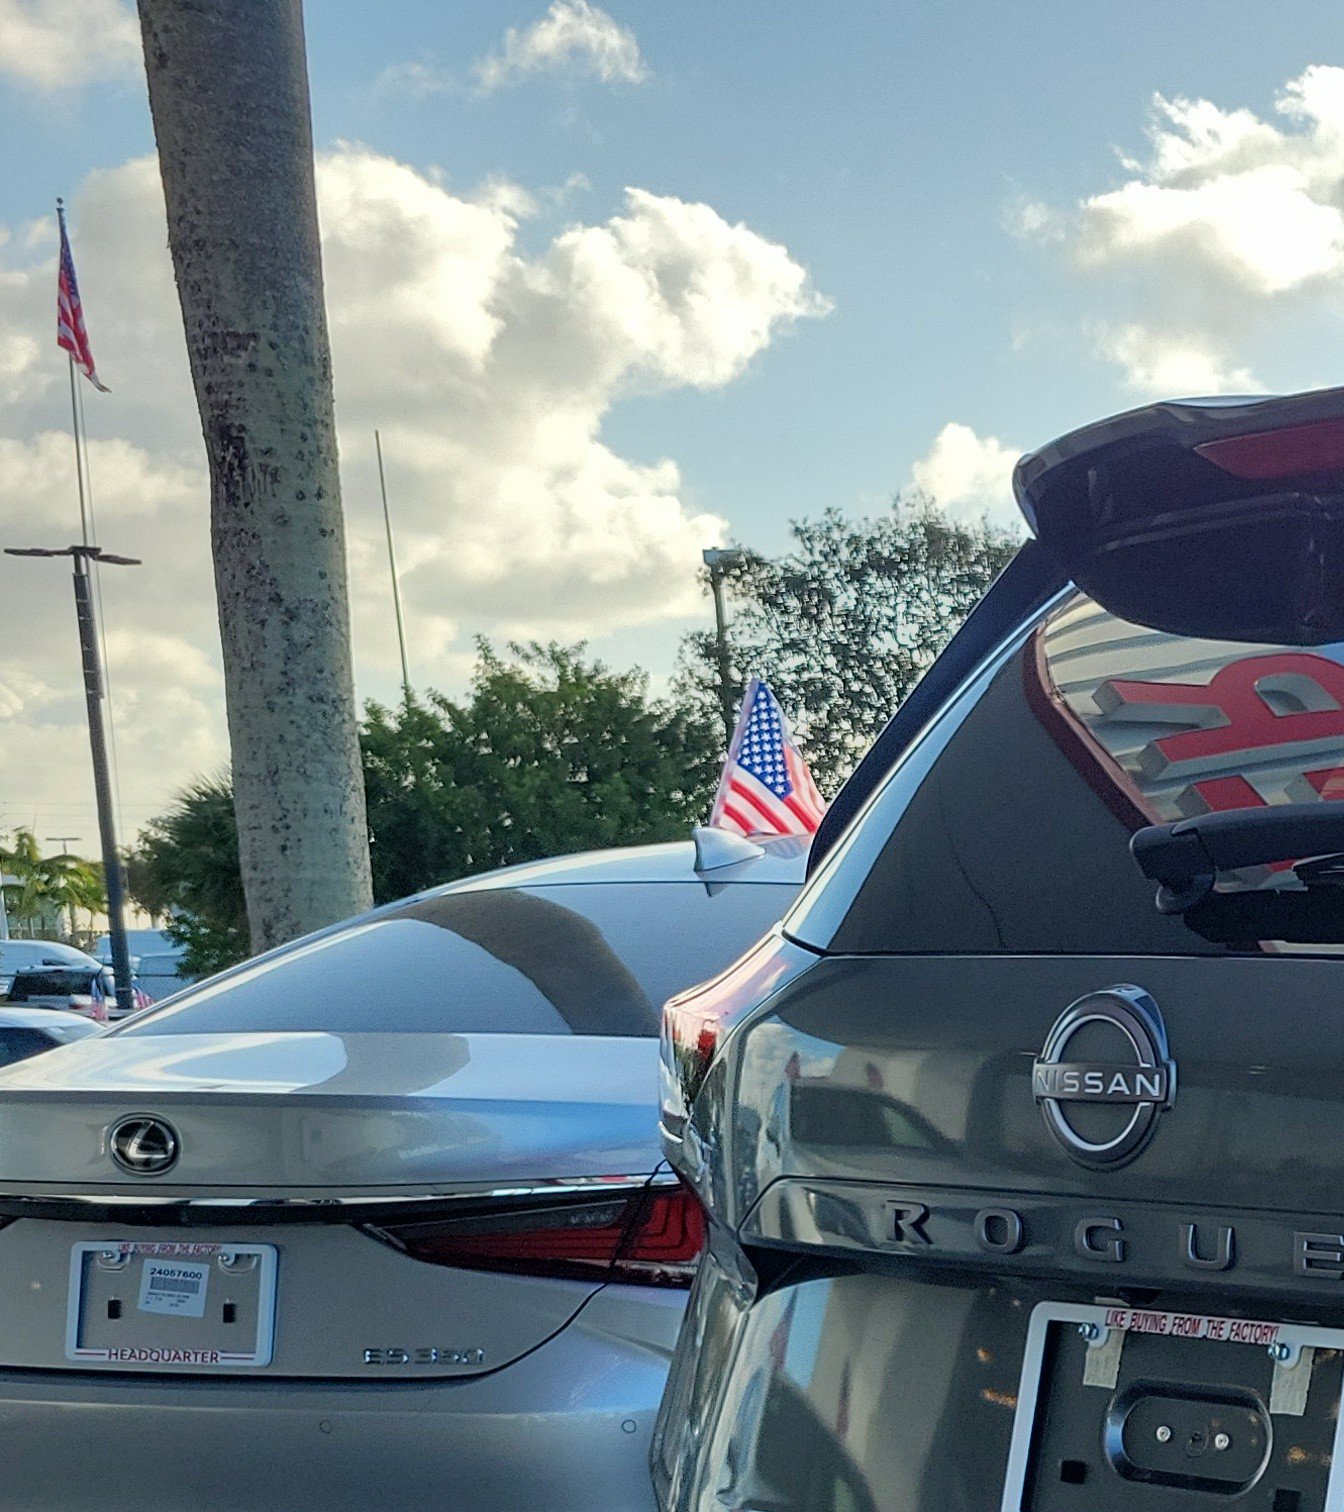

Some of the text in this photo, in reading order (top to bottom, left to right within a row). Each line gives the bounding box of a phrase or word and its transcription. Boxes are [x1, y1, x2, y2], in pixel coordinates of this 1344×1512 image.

[1037, 1071, 1160, 1097] NISSAN
[1105, 1309, 1127, 1328] LIKE
[1130, 1312, 1167, 1332] BUYING
[1172, 1316, 1202, 1335] FROM
[1206, 1319, 1225, 1338] THE
[107, 1348, 220, 1364] HEADQUARTER
[363, 1347, 410, 1365] ES
